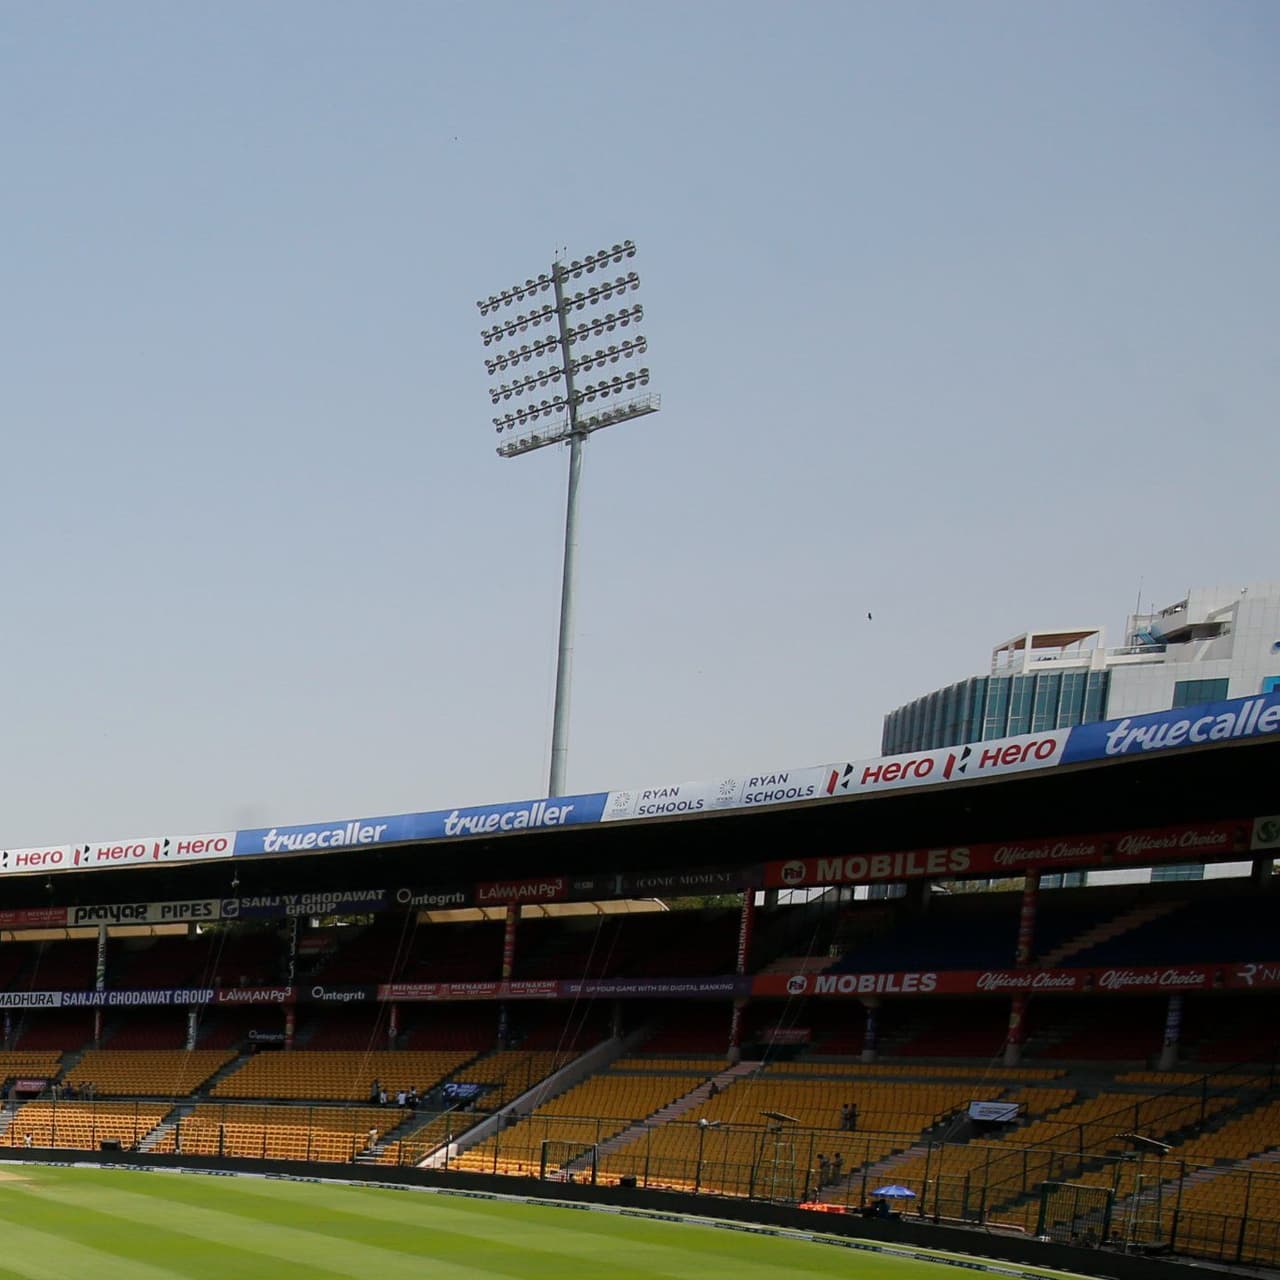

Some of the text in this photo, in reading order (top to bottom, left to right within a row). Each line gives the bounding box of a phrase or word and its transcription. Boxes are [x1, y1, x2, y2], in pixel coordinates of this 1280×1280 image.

[979, 738, 1057, 769] Hero
[748, 773, 788, 788] RYAN
[860, 757, 934, 785] Hero
[642, 786, 680, 800] RYAN
[744, 784, 814, 805] SCHOOLS
[638, 799, 704, 817] SCHOOLS
[443, 803, 575, 837] truecaller
[177, 836, 228, 857] Hero
[262, 821, 387, 853] truecaller
[1117, 830, 1228, 853] Officer's Choice
[15, 849, 63, 867] Hero
[96, 842, 146, 862] Hero
[993, 843, 1095, 864] Officer's Choice
[816, 848, 971, 882] MOBILES
[681, 873, 735, 886] MOMENT
[301, 889, 385, 905] GHODAWAT
[480, 884, 538, 899] LAWMAN
[75, 903, 212, 924] prayag PIPES
[285, 903, 336, 915] GROUP
[700, 983, 734, 991] BANKING
[814, 973, 937, 994] MOBILES
[977, 972, 1076, 990] Officer's Choice
[1099, 968, 1204, 989] Officer's Choice
[63, 989, 214, 1006] SANJAY GHODAWAT GROUP
[219, 989, 269, 1002] LAWMAN
